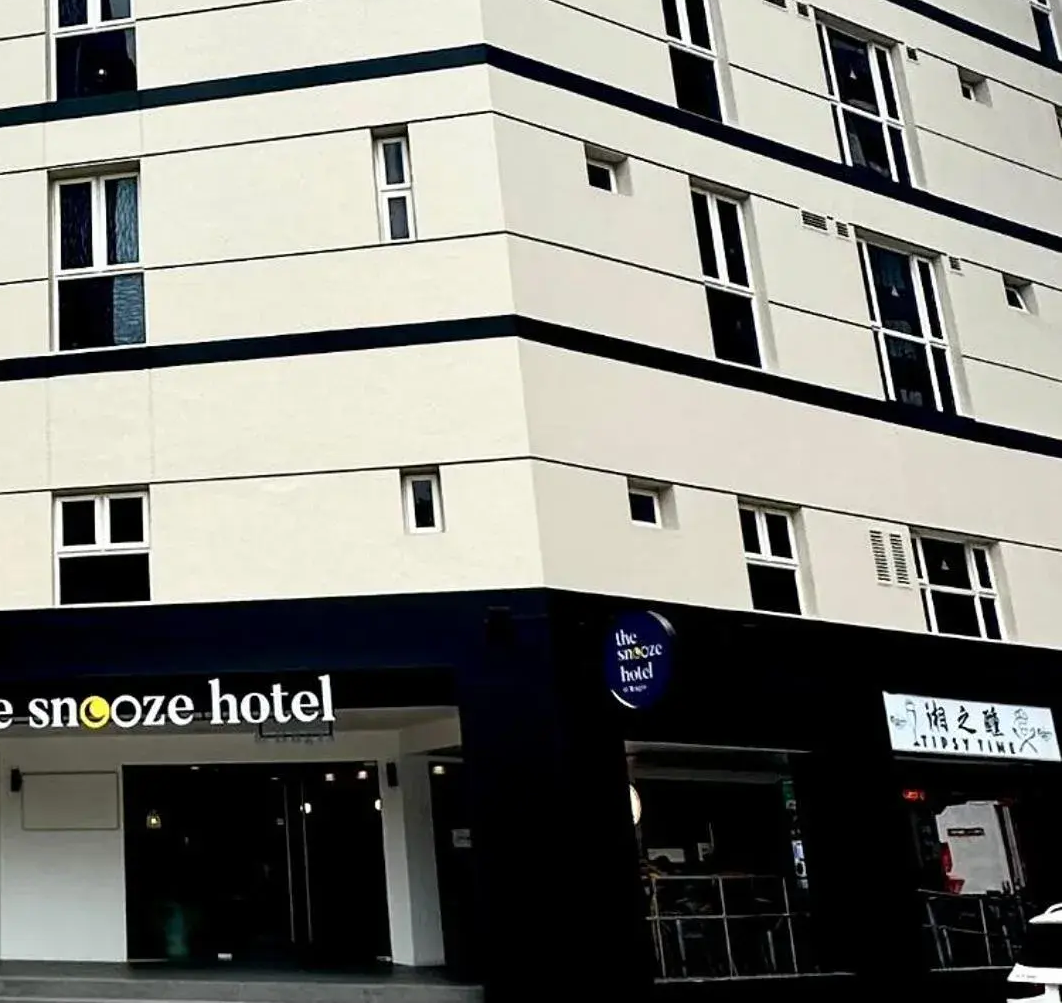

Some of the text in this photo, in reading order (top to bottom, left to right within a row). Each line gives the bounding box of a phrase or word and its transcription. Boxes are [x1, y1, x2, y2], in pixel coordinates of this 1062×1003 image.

[615, 629, 637, 647] the
[617, 643, 663, 660] snooze
[620, 661, 653, 683] hotel
[28, 694, 194, 729] snooze
[208, 674, 336, 724] hotel
